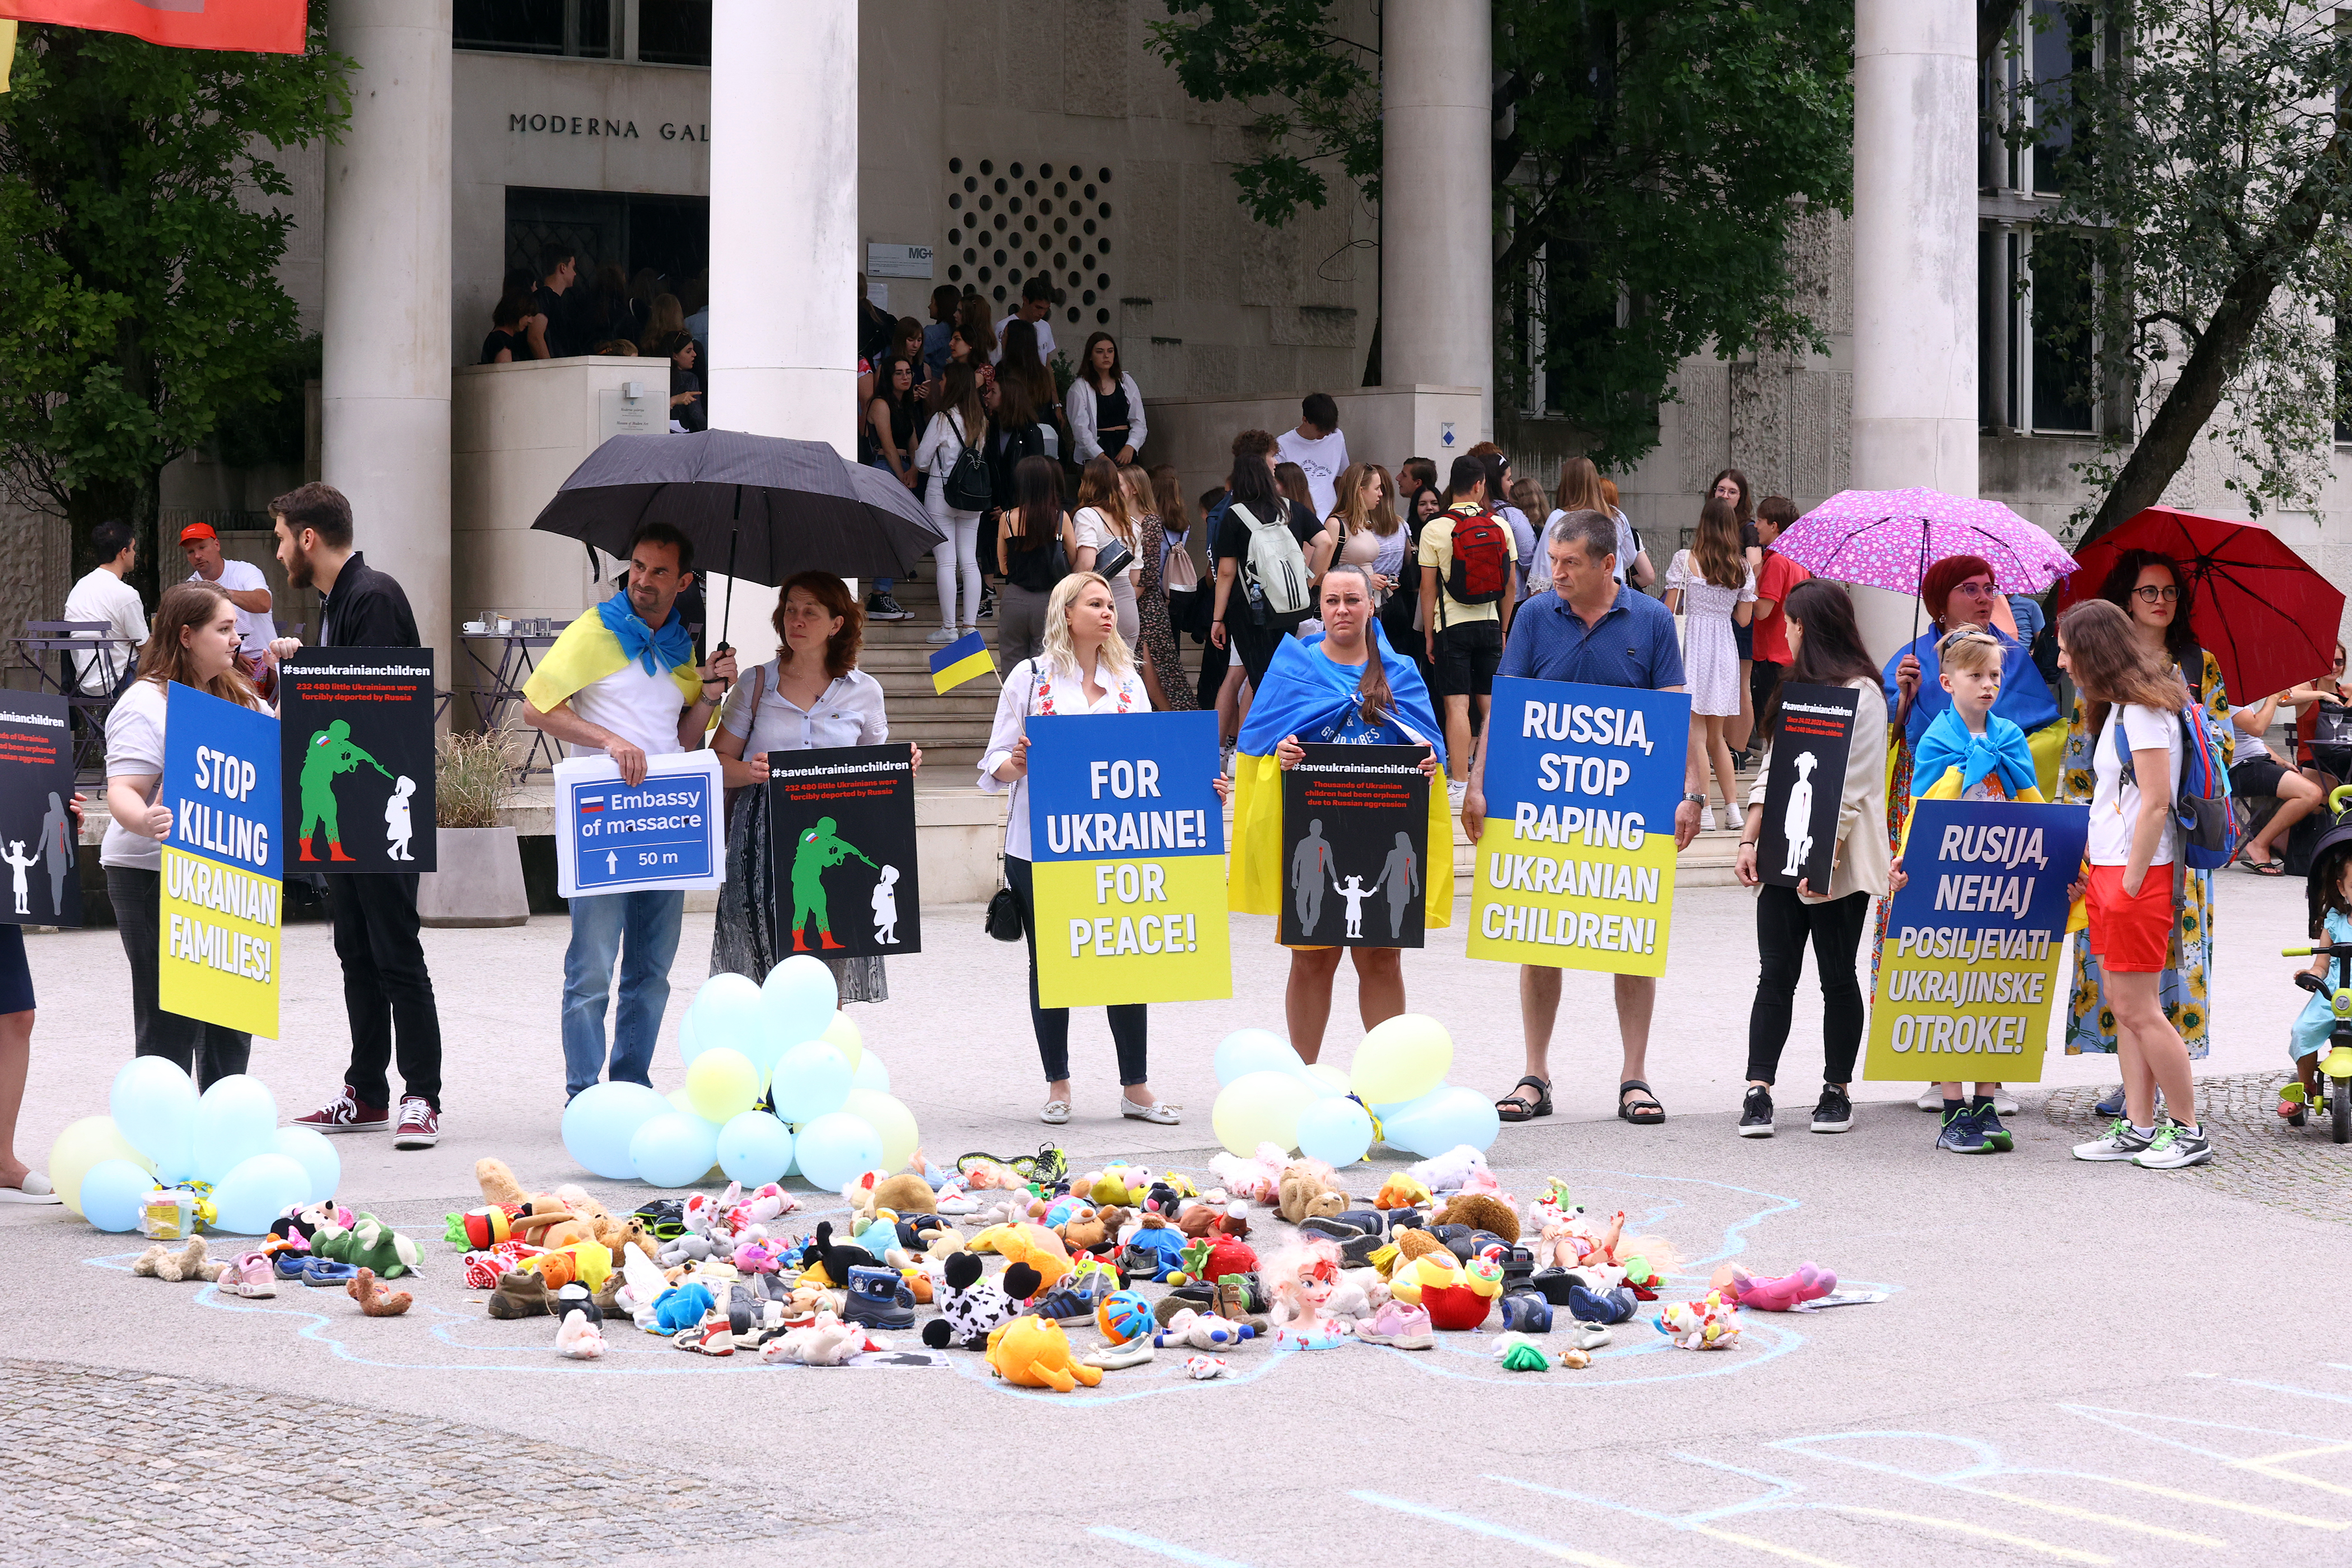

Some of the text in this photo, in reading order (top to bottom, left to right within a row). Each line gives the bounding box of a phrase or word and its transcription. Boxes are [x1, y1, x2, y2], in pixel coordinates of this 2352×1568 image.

[510, 114, 710, 142] MODERNA GAL
[282, 664, 431, 676] #saveukrainianchildren
[332, 683, 351, 691] little
[352, 683, 396, 692] Ukrainians
[301, 693, 334, 702] forcibly
[334, 693, 372, 702] deported
[373, 693, 384, 703] by
[1781, 701, 1853, 717] #saveukrainianchildren
[17, 733, 50, 744] Ukrainian
[1522, 700, 1654, 756] RUSSIA,
[1805, 727, 1826, 736] Ukrainian
[1825, 729, 1844, 738] children
[1822, 720, 1837, 728] Russia
[8, 742, 25, 752] been
[25, 745, 57, 755] orphaned
[18, 756, 55, 764] aggression
[195, 745, 256, 803] STOP
[772, 760, 909, 778] #saveukrainianchildren
[837, 780, 878, 788] Ukrainians
[1090, 759, 1161, 799] FOR
[1291, 762, 1424, 774] #saveukrainianchildren
[1537, 753, 1630, 796] STOP
[612, 791, 701, 810] Embassy
[790, 787, 893, 801] forcibly deported by Russia
[179, 798, 268, 866] KILLING
[582, 814, 702, 837] of massacre
[1047, 810, 1206, 853] UKRAINE!
[1514, 801, 1645, 850] RAPING
[638, 852, 678, 866] 50 m
[1938, 825, 2049, 871] RUSIJA,
[167, 853, 277, 927] UKRANIAN
[1095, 864, 1167, 903] FOR
[1488, 852, 1659, 903] UKRANIAN
[1934, 874, 2035, 920] NEHAJ
[1069, 913, 1197, 957] PEACE!
[1481, 903, 1656, 954] CHILDREN!
[1897, 926, 2051, 964] POSILJEVATI
[170, 913, 271, 983] FAMILIES!
[1888, 970, 2046, 1008] UKRAJINSKE
[1891, 1014, 2027, 1054] OTROKE!
